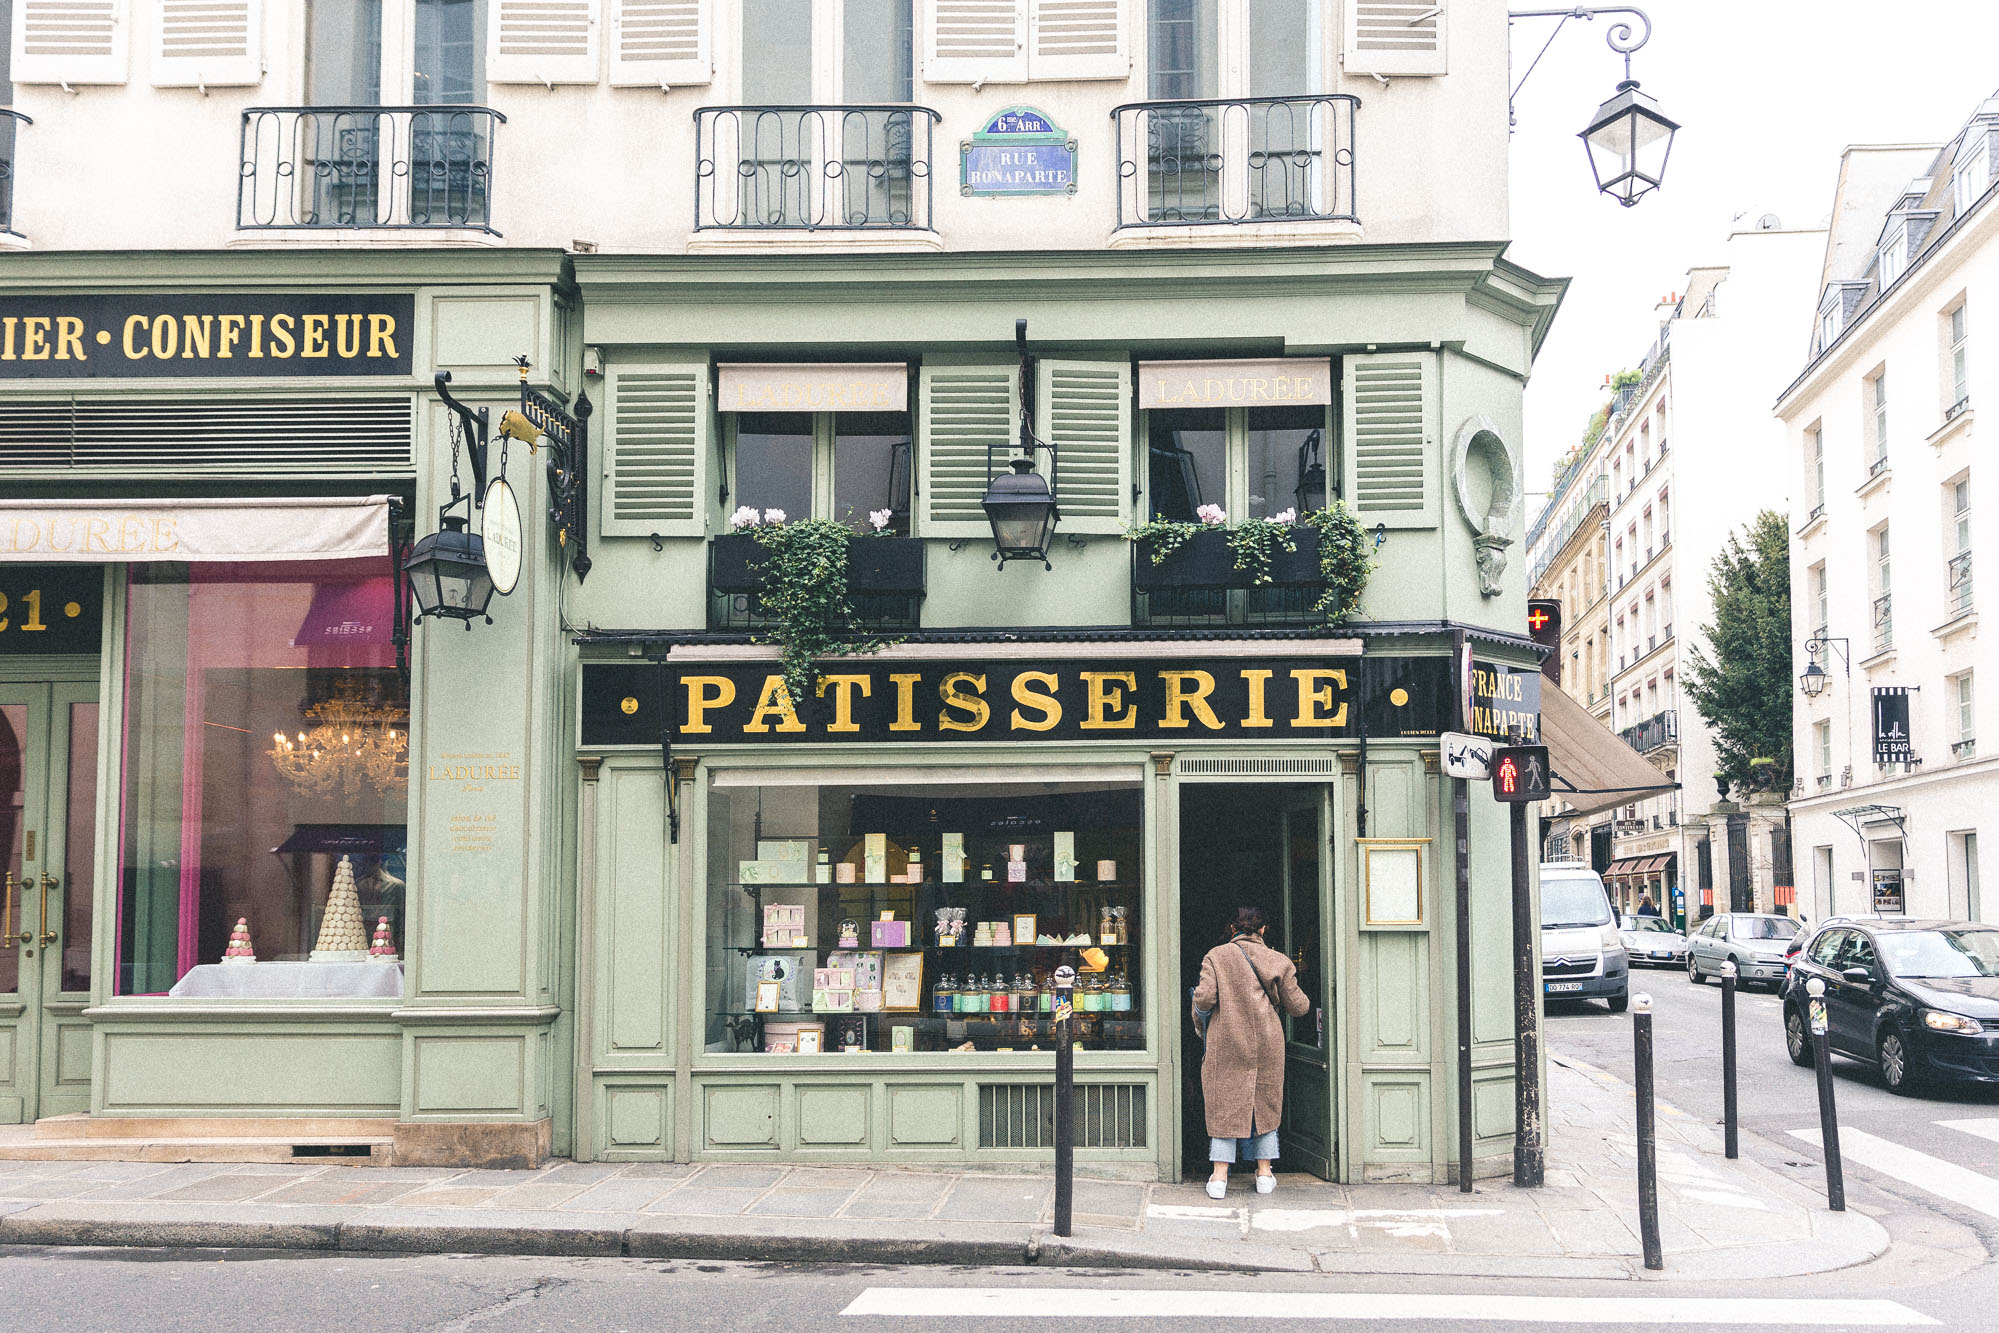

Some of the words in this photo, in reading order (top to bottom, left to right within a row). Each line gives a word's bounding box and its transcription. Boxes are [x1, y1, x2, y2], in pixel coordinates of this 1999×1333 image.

[1001, 152, 1037, 165] RUE
[971, 170, 1067, 184] BONAPARTE
[122, 313, 400, 360] CONFISEUR
[1157, 376, 1313, 403] LADURÉE
[0, 515, 179, 552] DURÉE
[679, 668, 1348, 734] PATISSERIE
[1878, 743, 1888, 752] LE
[1890, 743, 1909, 752] BAR
[429, 762, 521, 780] LADURÉE
